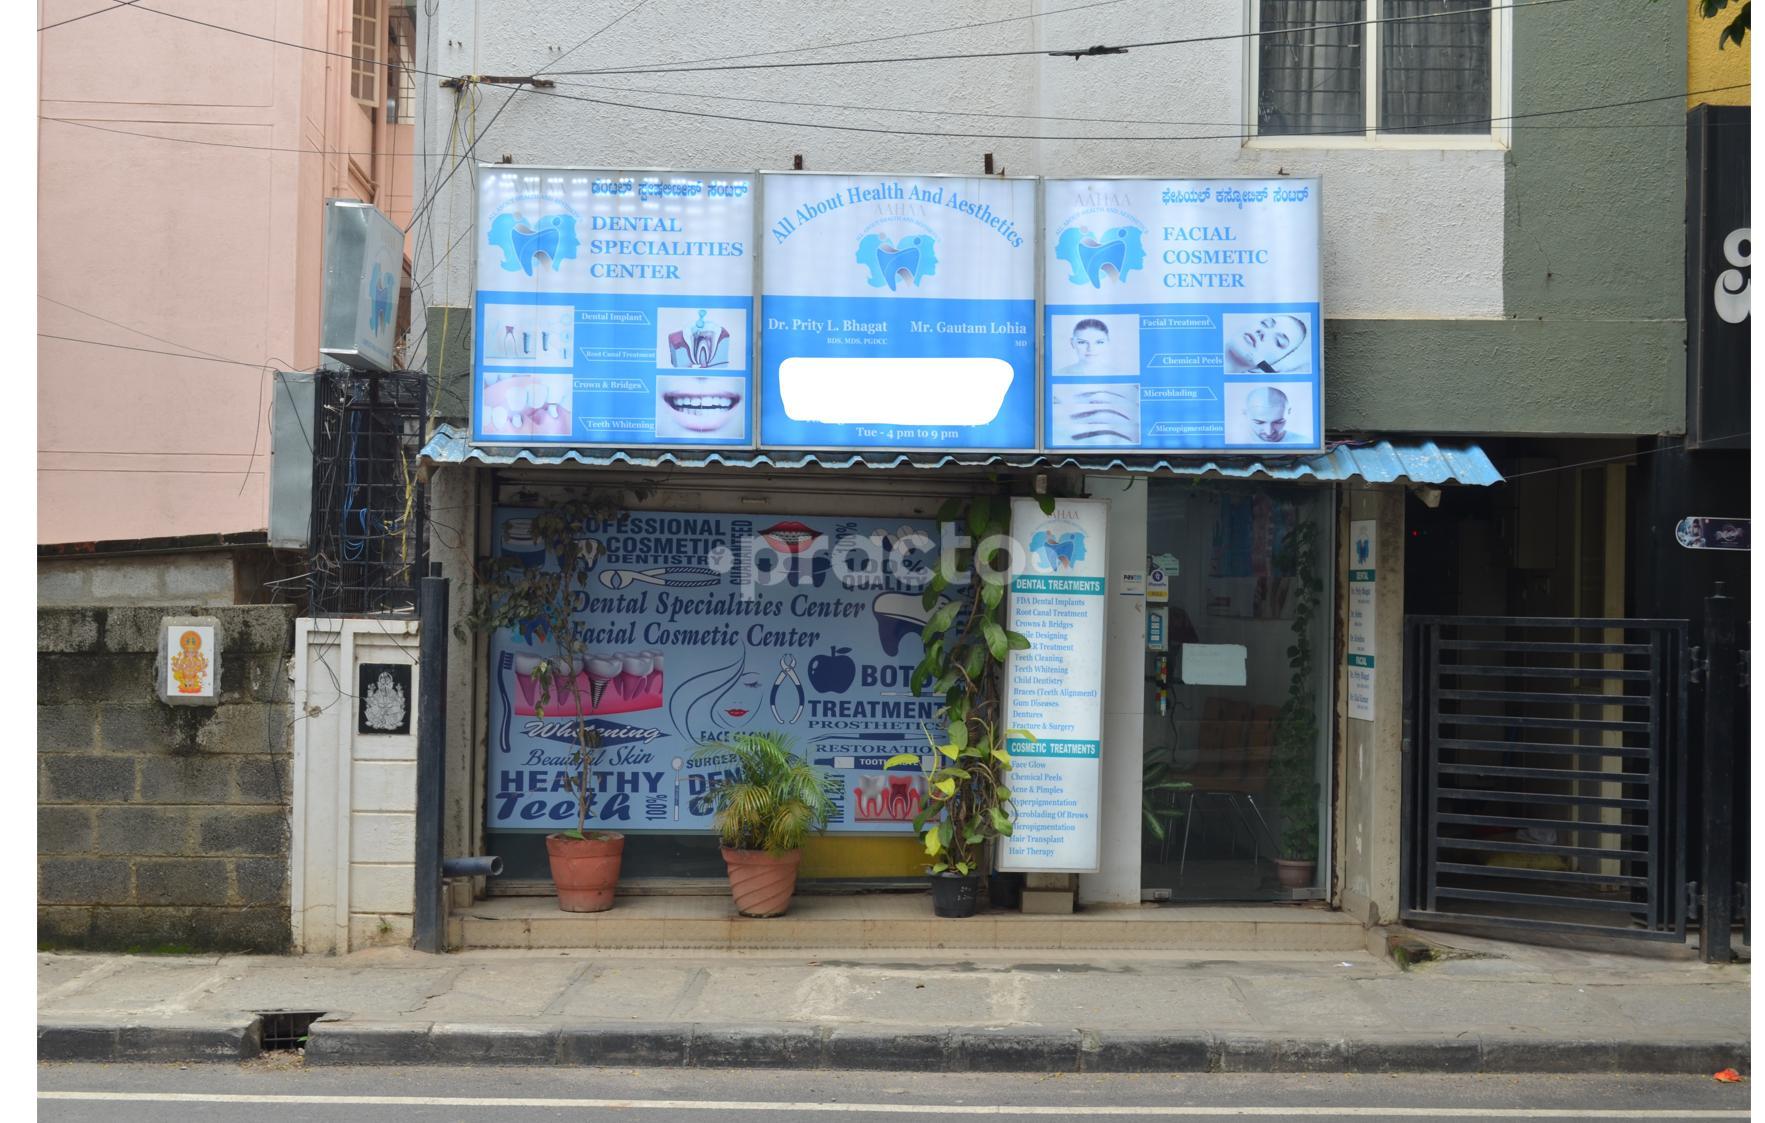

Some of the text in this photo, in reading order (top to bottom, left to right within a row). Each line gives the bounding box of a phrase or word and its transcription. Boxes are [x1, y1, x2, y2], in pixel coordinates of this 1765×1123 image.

[771, 217, 795, 244] All
[795, 192, 845, 225] About
[847, 183, 904, 205] Health
[908, 184, 943, 205] And
[945, 192, 1024, 248] Aesthetics
[592, 216, 682, 232] DENTAL
[1163, 227, 1237, 241] FACIAL
[590, 240, 744, 256] SPECIALITIES
[1163, 250, 1269, 264] COSMETIC
[590, 263, 680, 279] CENTER
[1163, 273, 1245, 288] CENTER
[581, 312, 643, 323] Dental Implant
[1143, 318, 1210, 327] Facial Treatment
[768, 318, 789, 330] Dr.
[792, 319, 824, 334] Prity
[843, 319, 887, 335] Bhagat
[910, 321, 1027, 334] Mr. Gautam Lohia
[603, 351, 621, 359] Canal
[622, 351, 656, 359] Treatment
[1163, 356, 1223, 365] Chemical Peels
[574, 381, 642, 391] Crown & Bridges
[1143, 389, 1197, 398] Microblading
[587, 420, 656, 431] Teeth Whitening
[1156, 424, 1223, 433] Micropigmentation
[856, 427, 877, 438] Tue
[887, 429, 894, 439] 4
[897, 430, 915, 440] pm
[917, 429, 929, 438] to
[931, 431, 938, 441] 9
[941, 431, 959, 441] pm
[584, 518, 726, 536] OFESSIONAL
[606, 537, 726, 555] COSMETIC
[730, 520, 752, 585] GUARANTEED
[607, 554, 724, 566] DENTISTRY
[845, 558, 928, 574] 100%
[842, 576, 928, 592] QUALITY
[1016, 578, 1101, 592] DENTAL TREATMENTS
[572, 591, 866, 622] Dental Specialities Center
[1016, 597, 1085, 607] FDA Dental Implants
[1016, 608, 1088, 617] Root Canal Treatment
[1048, 620, 1074, 630] Bridges
[572, 621, 820, 648] Facial Cosmetic Center
[1035, 631, 1068, 641] Designing
[1040, 642, 1073, 651] Treatment
[1015, 653, 1064, 663] Teeth Cleaning
[1015, 665, 1068, 674] Teeth Whitening
[861, 664, 933, 688] BOT
[1014, 676, 1063, 686] Child Dentistry
[1013, 688, 1097, 698] Braces (Teeth Alignment)
[1013, 699, 1030, 707] Gum
[808, 700, 946, 719] TREATMENT
[808, 720, 945, 731] PROSTHETICS
[1013, 722, 1041, 730] Fracture
[1048, 722, 1074, 731] Surgery
[700, 730, 730, 743] FACE
[816, 744, 932, 754] RESTORATIO
[1012, 742, 1096, 754] COSMETIC TREATMENTS
[610, 746, 656, 766] Skin
[686, 753, 743, 769] SURGER
[1011, 760, 1046, 768] Face Glow
[500, 770, 665, 793] HEALTHY
[1011, 772, 1063, 781] Chemical Peels
[1011, 785, 1028, 793] Acne
[1036, 786, 1063, 795] Pimples
[495, 792, 631, 821] Teeth
[646, 794, 668, 821] 100%
[1011, 797, 1077, 807] Hyperpigmentation
[1010, 810, 1056, 819] Microblading
[1009, 835, 1064, 844] Hair Transplant
[1009, 847, 1054, 857] Hair Therapy
